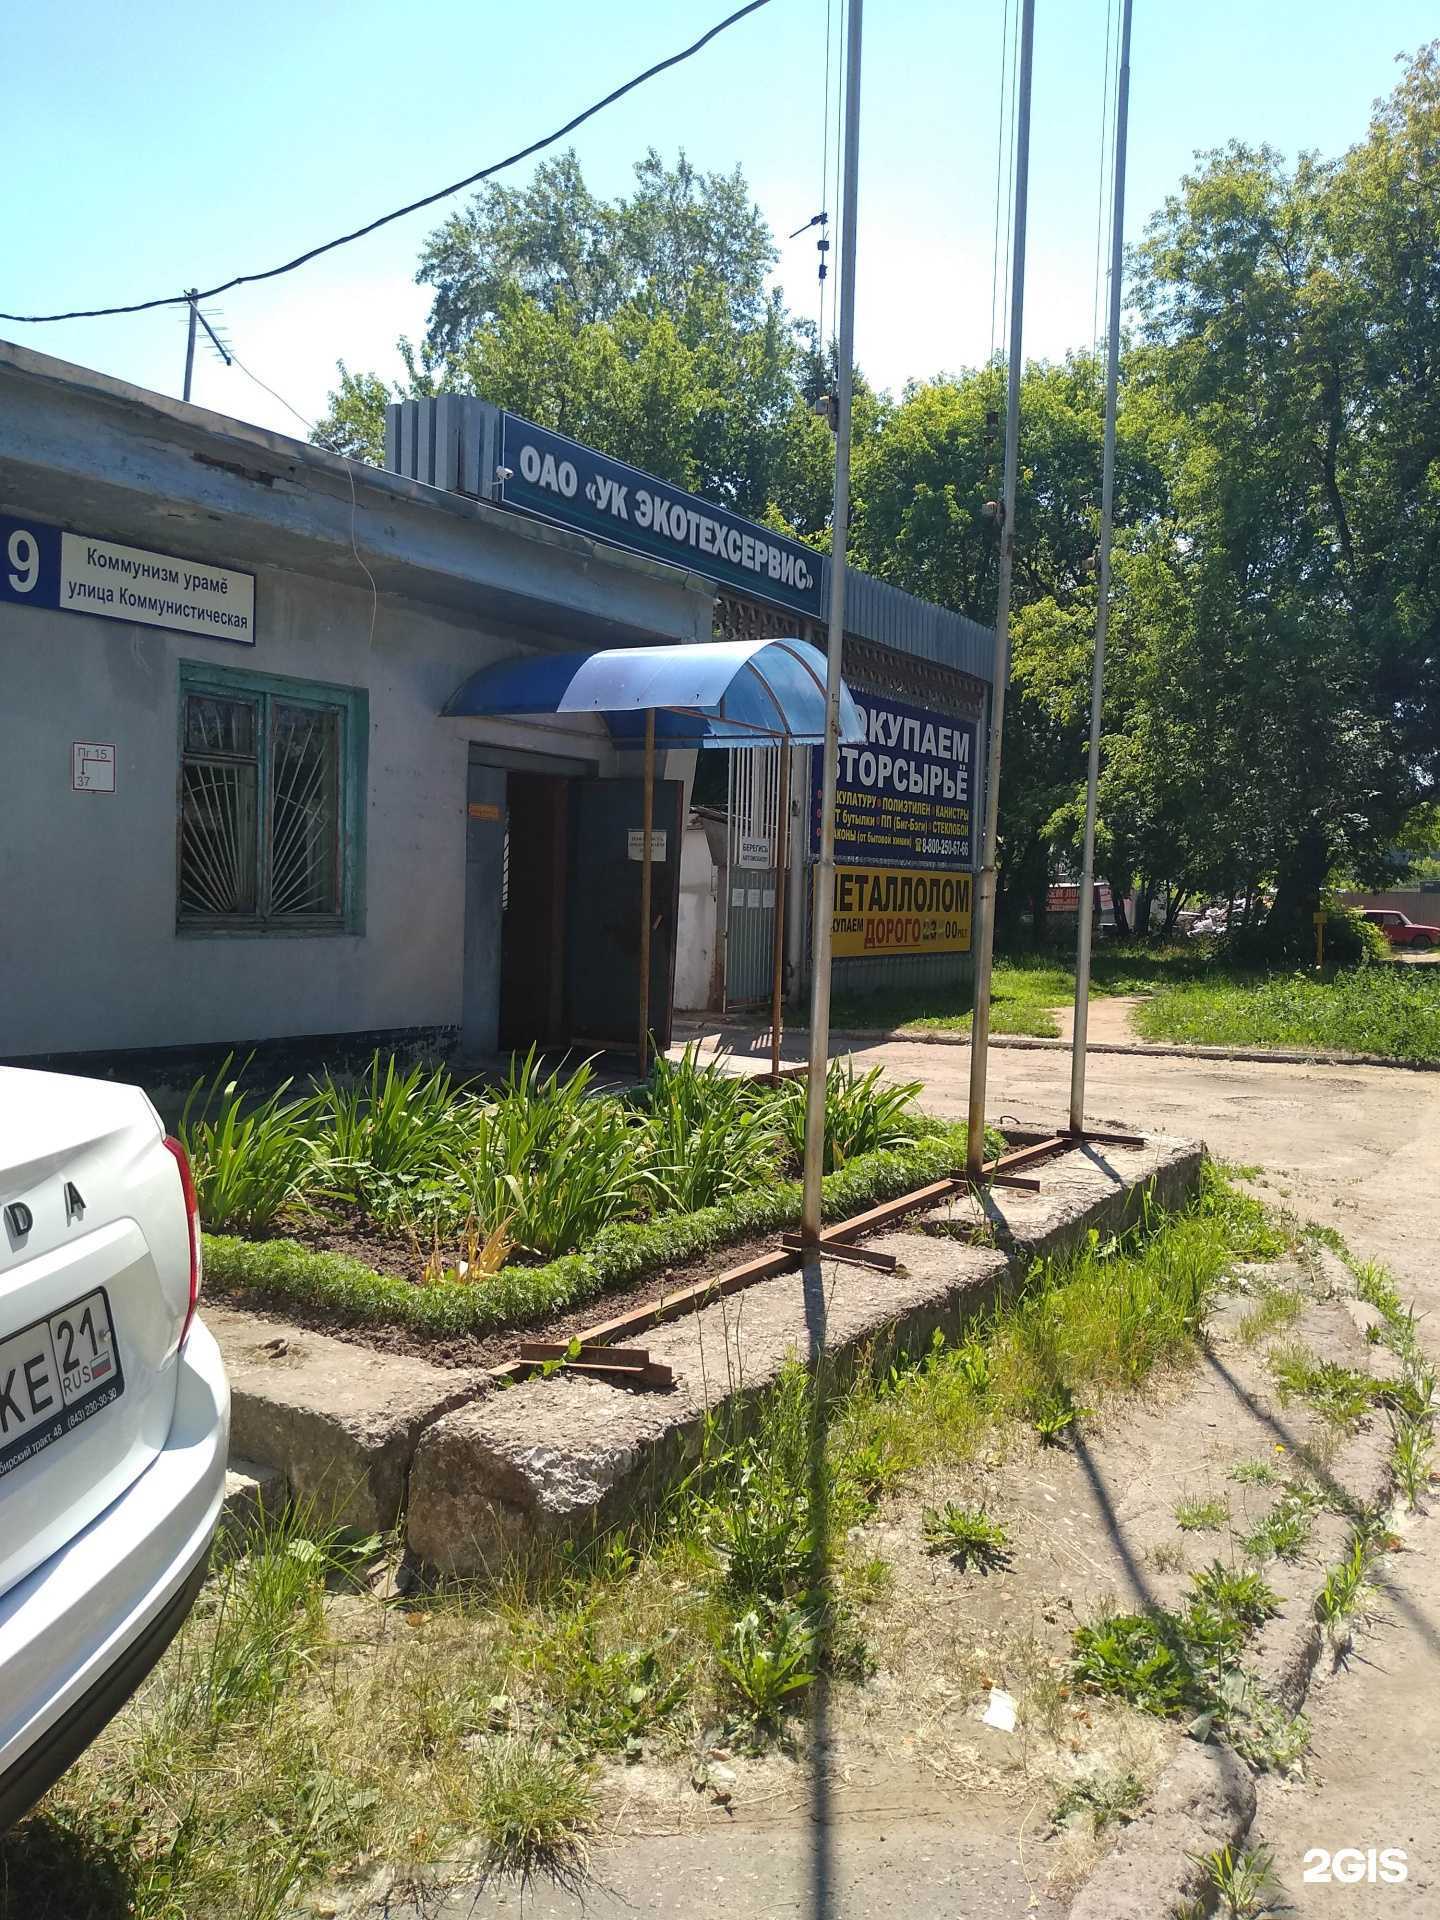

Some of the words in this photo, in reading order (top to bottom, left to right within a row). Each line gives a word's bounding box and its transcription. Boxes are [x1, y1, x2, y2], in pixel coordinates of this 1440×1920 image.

[519, 445, 578, 497] ОАО
[585, 474, 629, 521] «УК
[634, 489, 815, 590] ЭКОТЕХСЕРВИС»
[8, 530, 40, 593] 9
[87, 547, 179, 584] Коммунизм
[68, 580, 114, 603] улица
[119, 586, 248, 629] Коммунистическая
[854, 704, 970, 763] КУПАЕМ
[96, 748, 108, 760] 15
[836, 790, 877, 809] КУЛАТУРУ
[882, 797, 931, 817] ПОЛИЭТИЛЕН
[935, 803, 969, 821] КАНИСТРЫ
[842, 809, 875, 827] бутылки
[834, 873, 970, 913] ЕТАЛЛОЛОМ
[832, 918, 864, 933] КУПАЕМ
[864, 918, 920, 947] ДОРОГО
[57, 1307, 98, 1375] 21
[62, 1365, 92, 1397] RUS
[53, 1424, 63, 1439] 48
[67, 1410, 85, 1429] (843)
